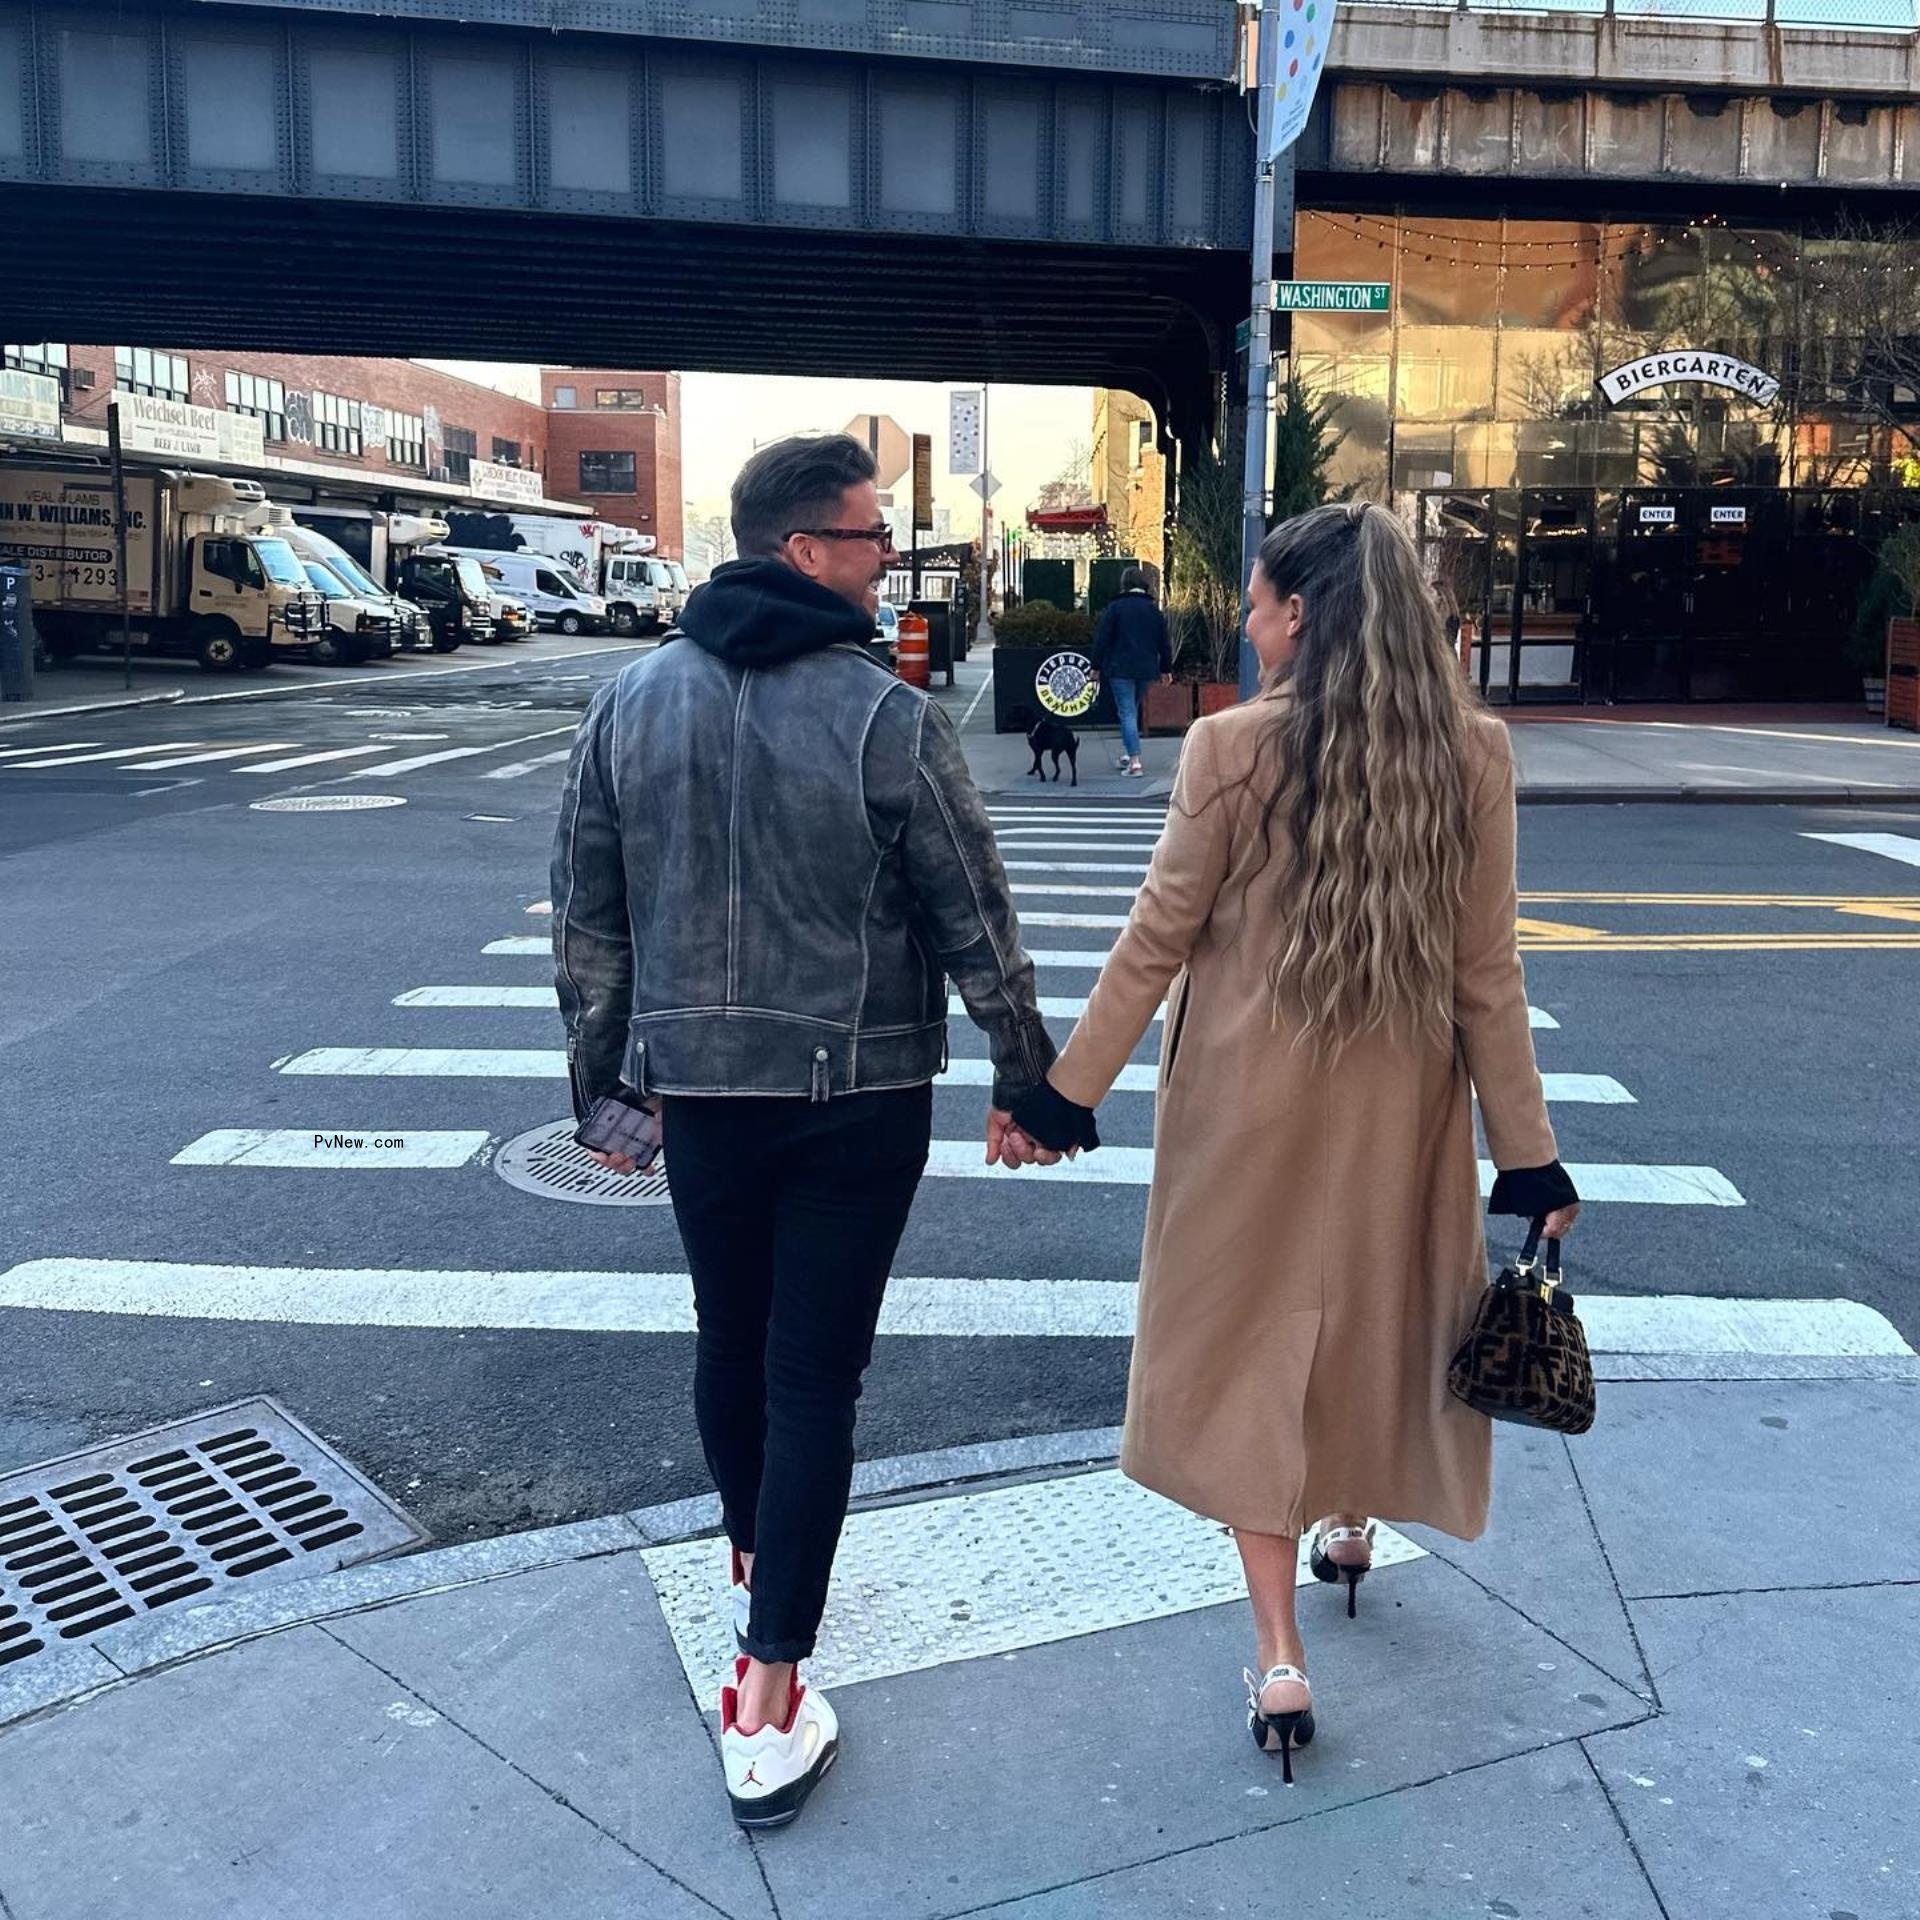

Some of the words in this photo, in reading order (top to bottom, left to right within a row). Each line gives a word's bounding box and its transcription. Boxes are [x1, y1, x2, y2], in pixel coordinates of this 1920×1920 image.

[1280, 285, 1371, 308] WASHINGTON
[1374, 287, 1386, 299] ST
[1615, 356, 1766, 394] BIERGARTEN
[190, 408, 216, 431] Beef
[17, 503, 36, 521] W.
[120, 510, 147, 529] NC.
[1642, 509, 1673, 520] ENTER
[1713, 509, 1744, 520] ENTER
[7, 576, 16, 590] P
